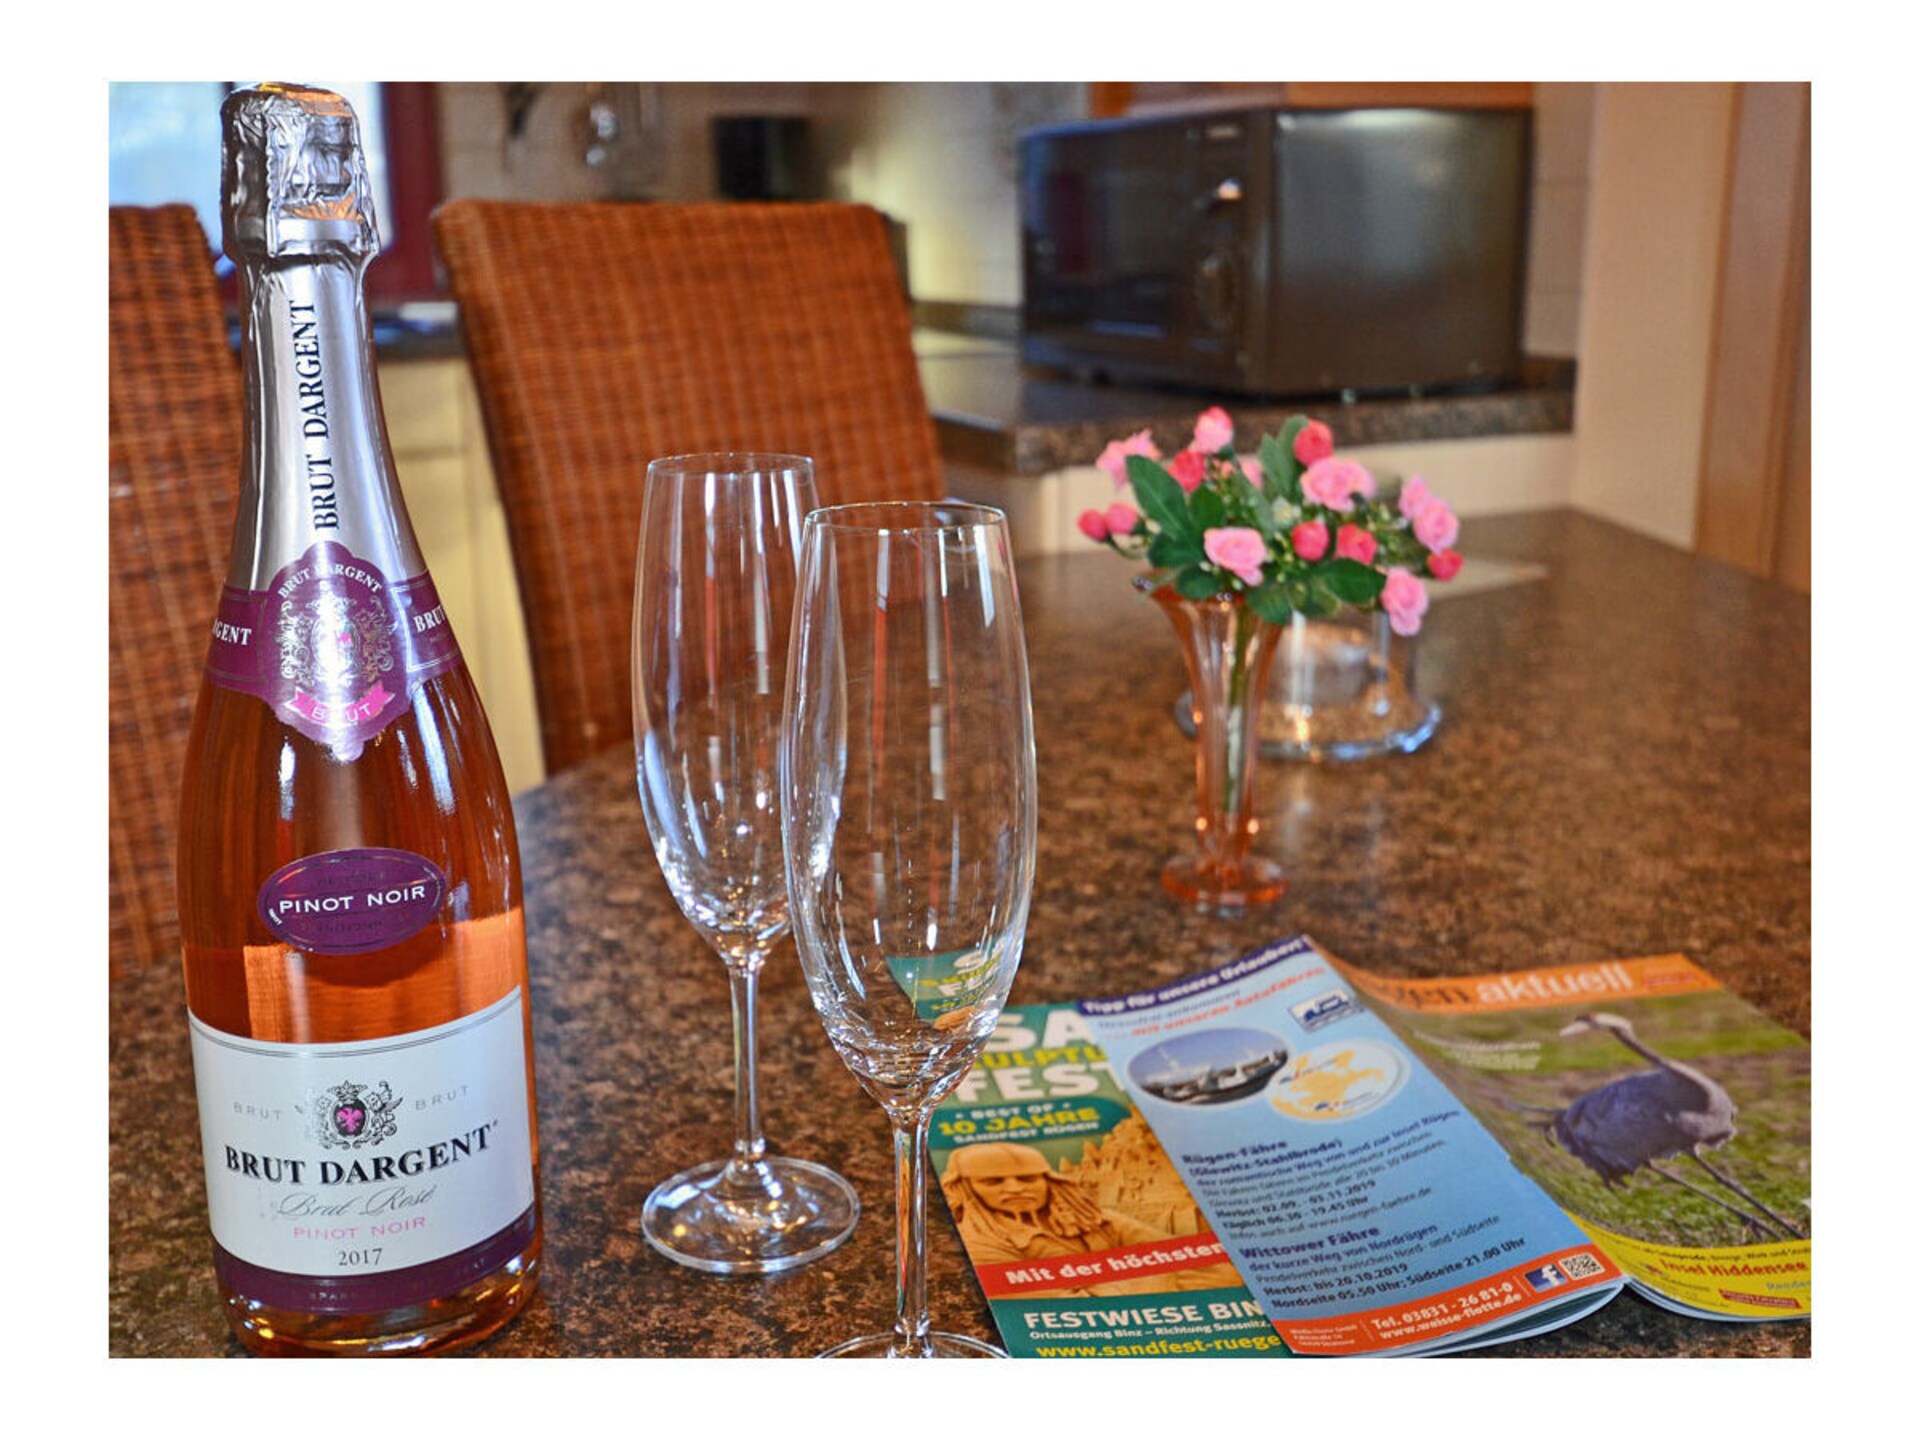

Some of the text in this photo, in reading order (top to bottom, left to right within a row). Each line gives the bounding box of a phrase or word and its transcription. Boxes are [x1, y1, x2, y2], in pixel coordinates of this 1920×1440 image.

[289, 300, 339, 530] BRUT DARGENT
[278, 564, 382, 599] BRUT ARGENT
[311, 703, 372, 723] BUT
[279, 885, 425, 914] PINOT NOIR
[1083, 1000, 1125, 1015] Tipp
[1127, 993, 1156, 1009] für
[1157, 974, 1219, 1001] unsere
[1477, 962, 1634, 1004] aktuell
[233, 1101, 281, 1122] BRUT
[415, 1085, 469, 1111] BRUT
[971, 1102, 1054, 1120] BEST OF
[938, 1107, 1100, 1136] 10 JAHRE
[953, 1120, 1099, 1144] SANDFEST RÜGEN
[224, 1124, 491, 1186] BRUT DARGENT
[276, 1191, 351, 1218] Brut
[293, 1216, 426, 1241] PINOT NOIR
[1239, 1227, 1380, 1259] Wittower Fähre
[338, 1248, 383, 1267] 2017
[1005, 1266, 1054, 1285] Mit
[1060, 1260, 1103, 1279] der
[1263, 1263, 1408, 1297] Herbst: bis 20.10.2019
[1271, 1292, 1336, 1309] Nordseite
[1338, 1286, 1376, 1300] 05.50
[1406, 1261, 1463, 1286] Südseite
[1465, 1246, 1500, 1268] 21.00
[1501, 1236, 1526, 1252] Uhr
[1023, 1304, 1204, 1329] FESTWIESE
[1372, 1315, 1402, 1331] Tel.
[1402, 1303, 1450, 1325] 03831
[1458, 1291, 1479, 1308] 26
[1479, 1281, 1514, 1300] 81-0
[1379, 1293, 1523, 1340] www.weisse-flotte.de
[1030, 1329, 1112, 1342] Ortsausgang
[1114, 1327, 1143, 1338] Binz
[1155, 1323, 1211, 1338] Richtung
